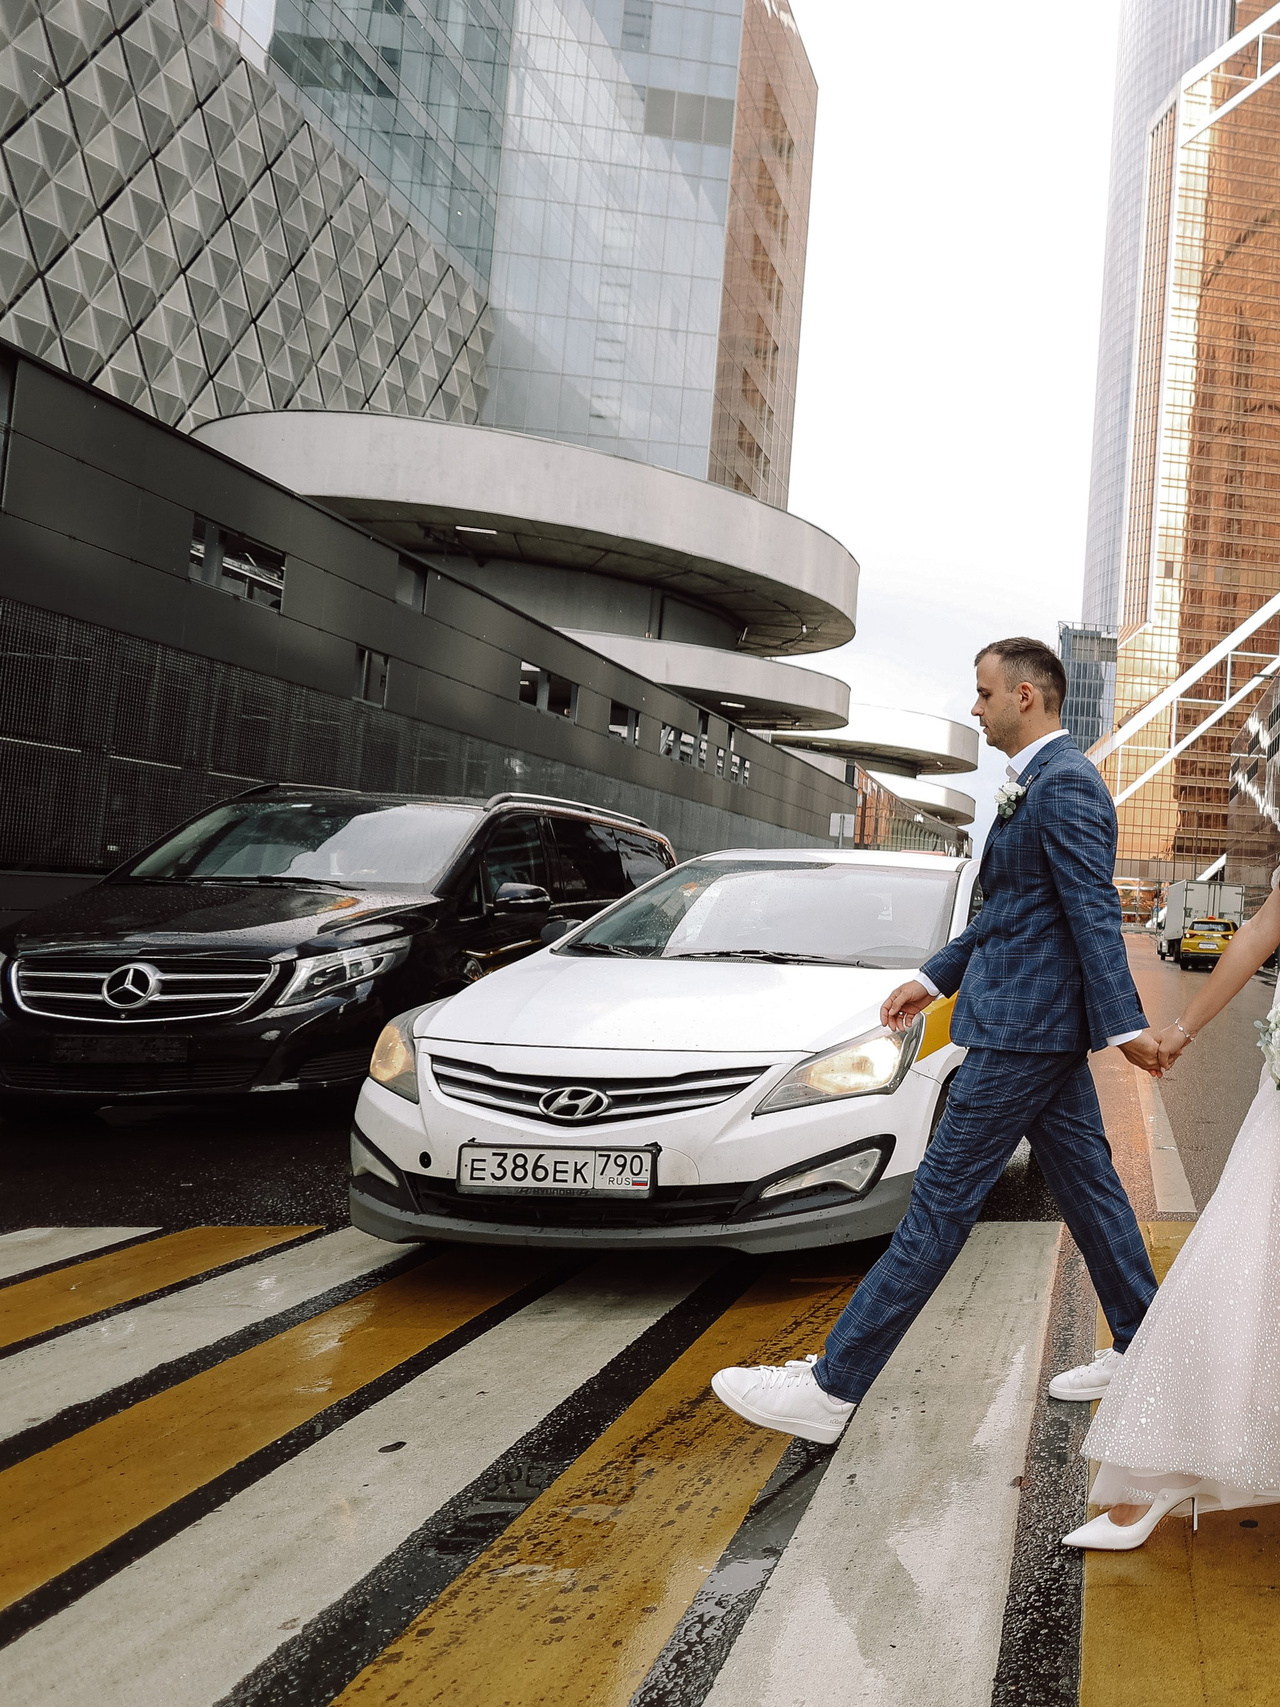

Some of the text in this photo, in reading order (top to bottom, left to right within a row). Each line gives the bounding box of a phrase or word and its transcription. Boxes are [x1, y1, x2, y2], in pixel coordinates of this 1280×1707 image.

[469, 1152, 645, 1184] E386EK 790
[608, 1176, 631, 1187] RUS
